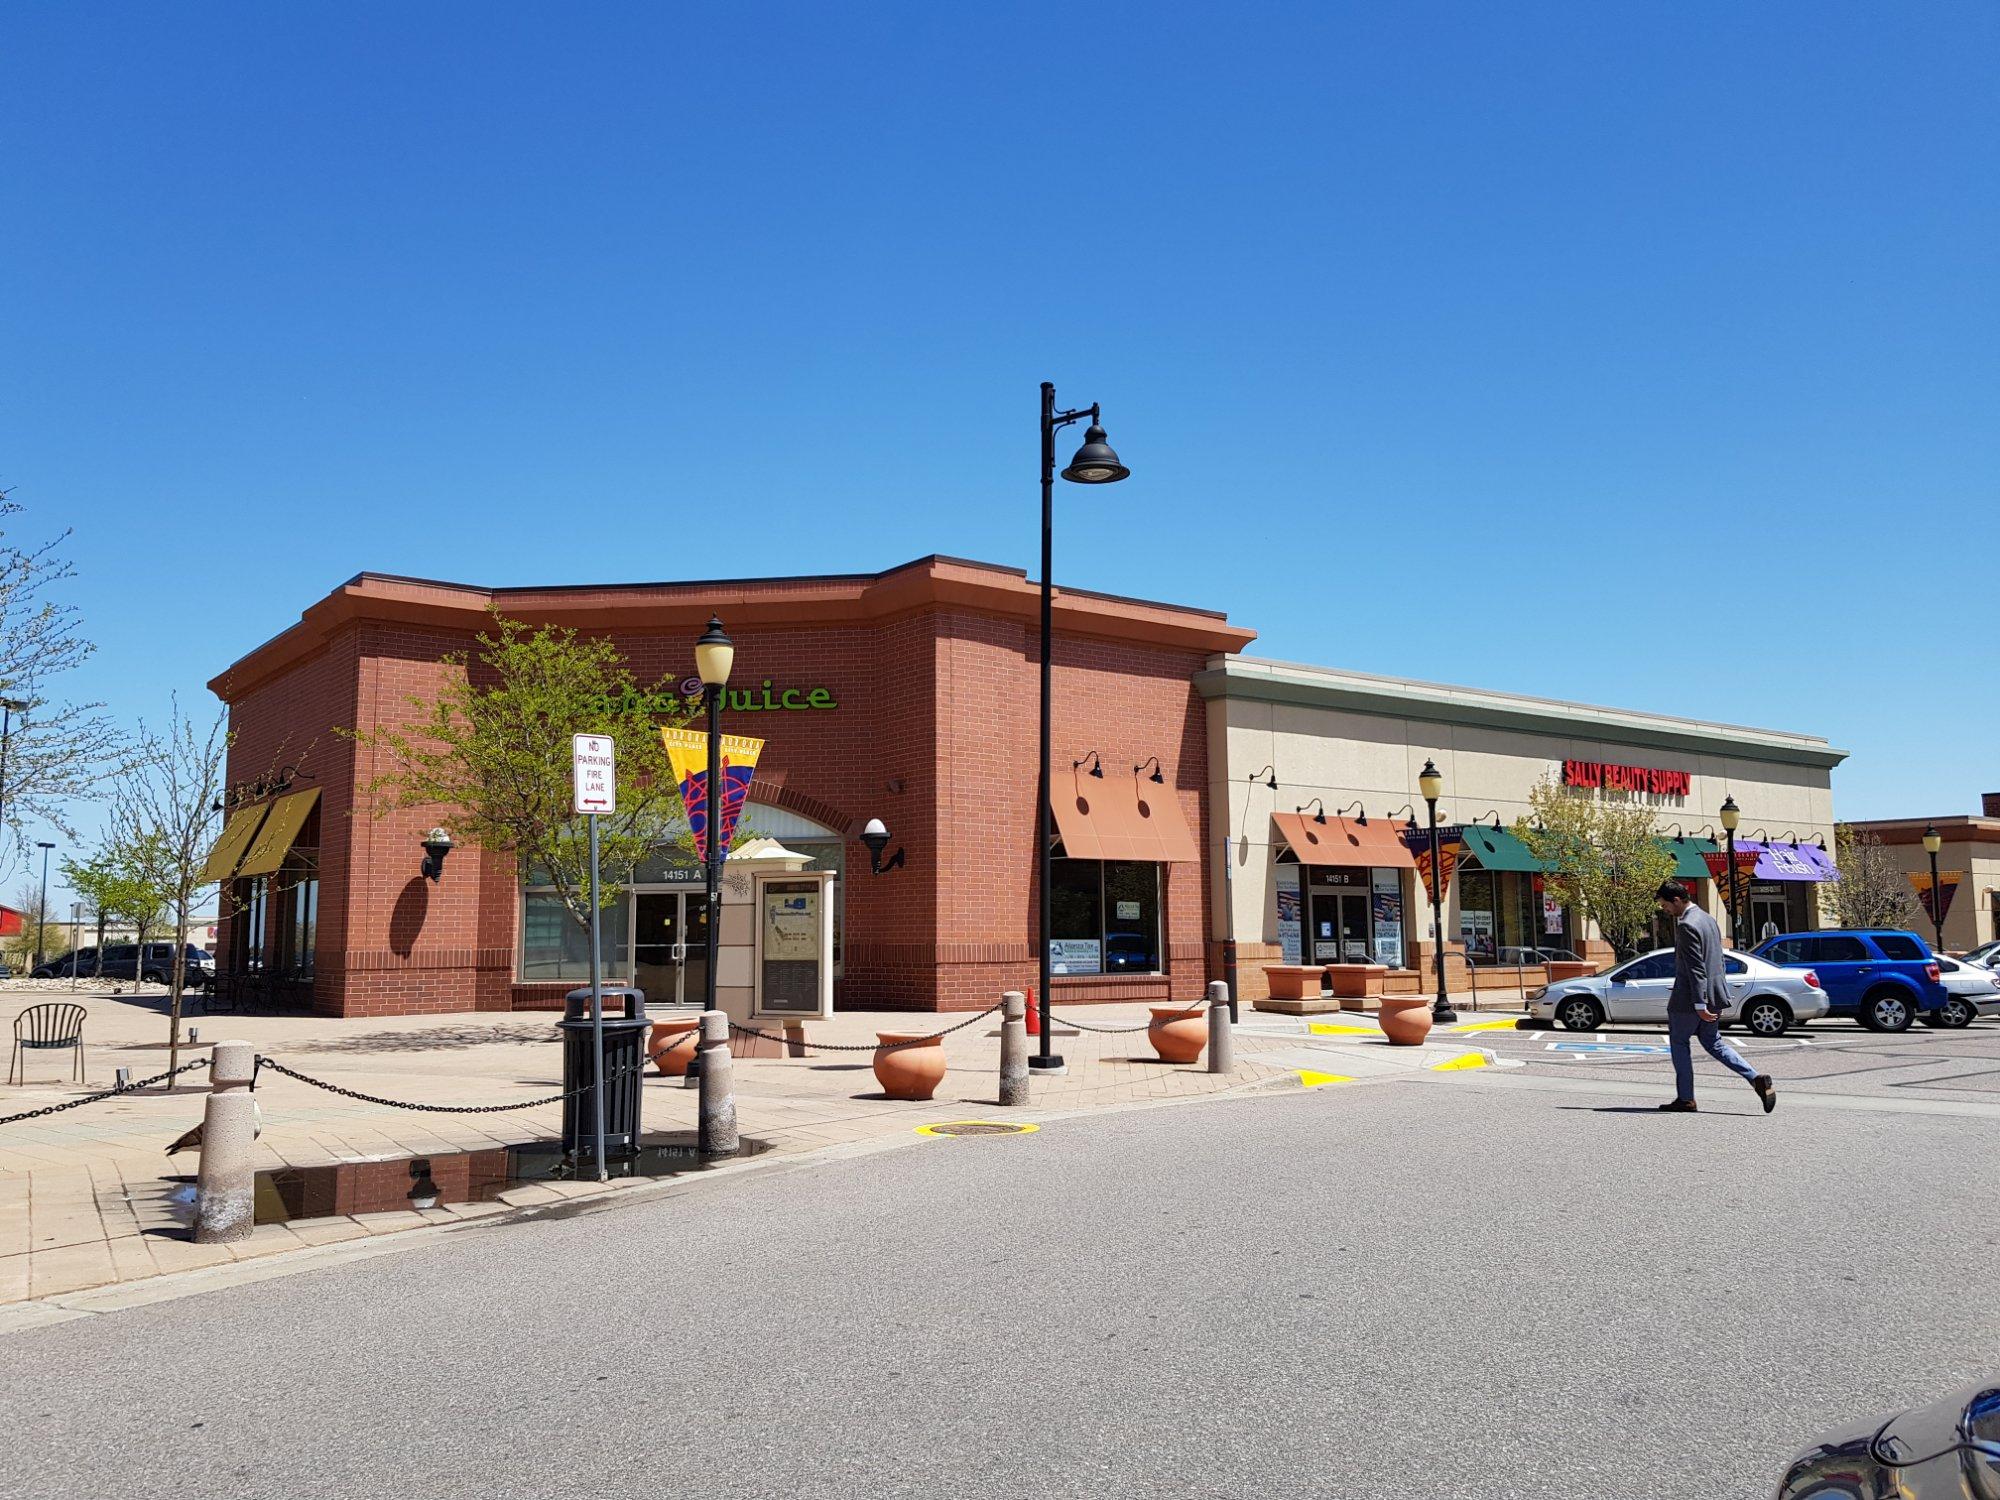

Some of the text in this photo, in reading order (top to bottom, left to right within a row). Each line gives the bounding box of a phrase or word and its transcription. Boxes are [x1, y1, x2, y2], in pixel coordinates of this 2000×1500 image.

[588, 741, 600, 752] NO
[577, 755, 611, 767] PARKING
[586, 770, 603, 780] FIRE
[1565, 759, 1691, 796] SALLY BEAUTY SUPPLY
[585, 782, 605, 792] LANE
[1768, 848, 1798, 861] Hair
[1773, 860, 1815, 875] Fetish
[663, 869, 702, 880] 14151 A
[1325, 875, 1349, 883] 14151 B
[1544, 900, 1557, 912] 50
